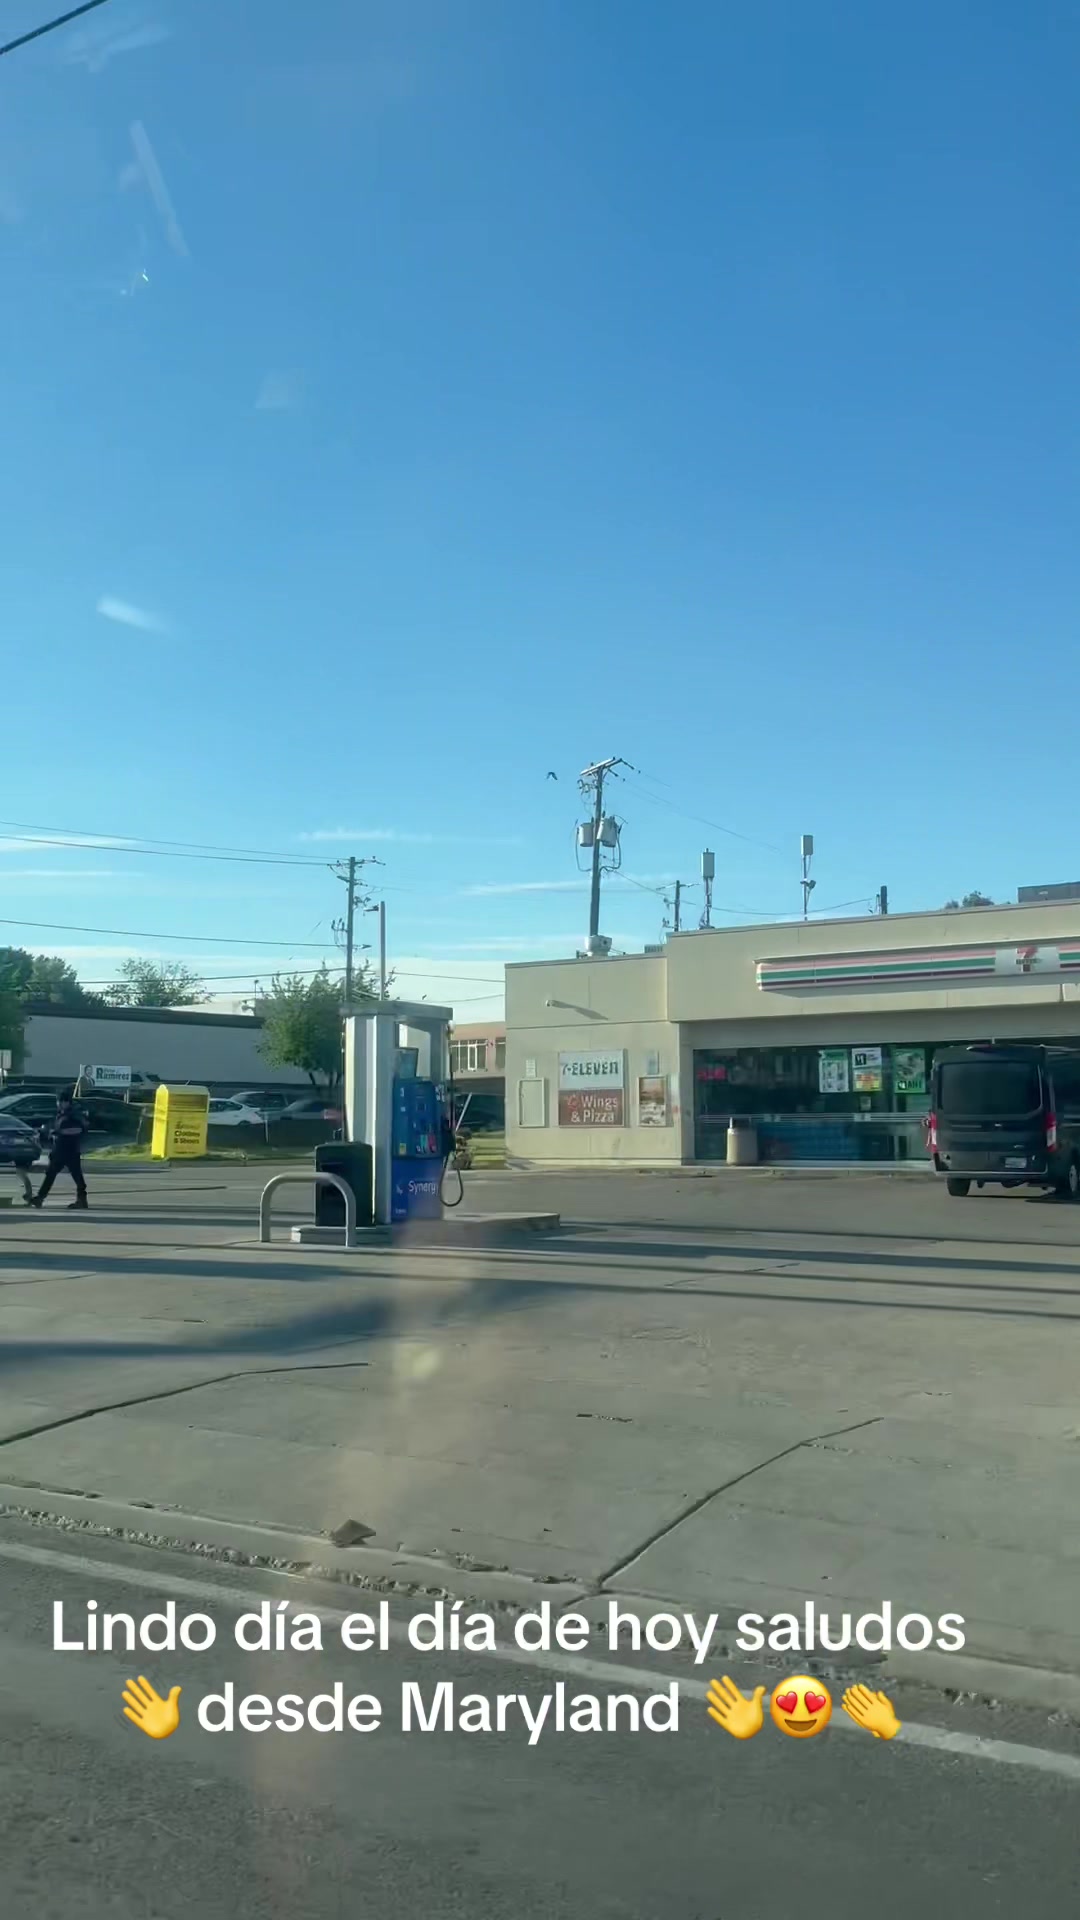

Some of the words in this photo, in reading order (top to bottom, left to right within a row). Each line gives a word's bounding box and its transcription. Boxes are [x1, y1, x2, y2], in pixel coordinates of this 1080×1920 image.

[581, 1095, 617, 1111] Wings
[571, 1110, 580, 1122] &
[583, 1109, 615, 1122] Pizza
[408, 1180, 439, 1196] Synergy
